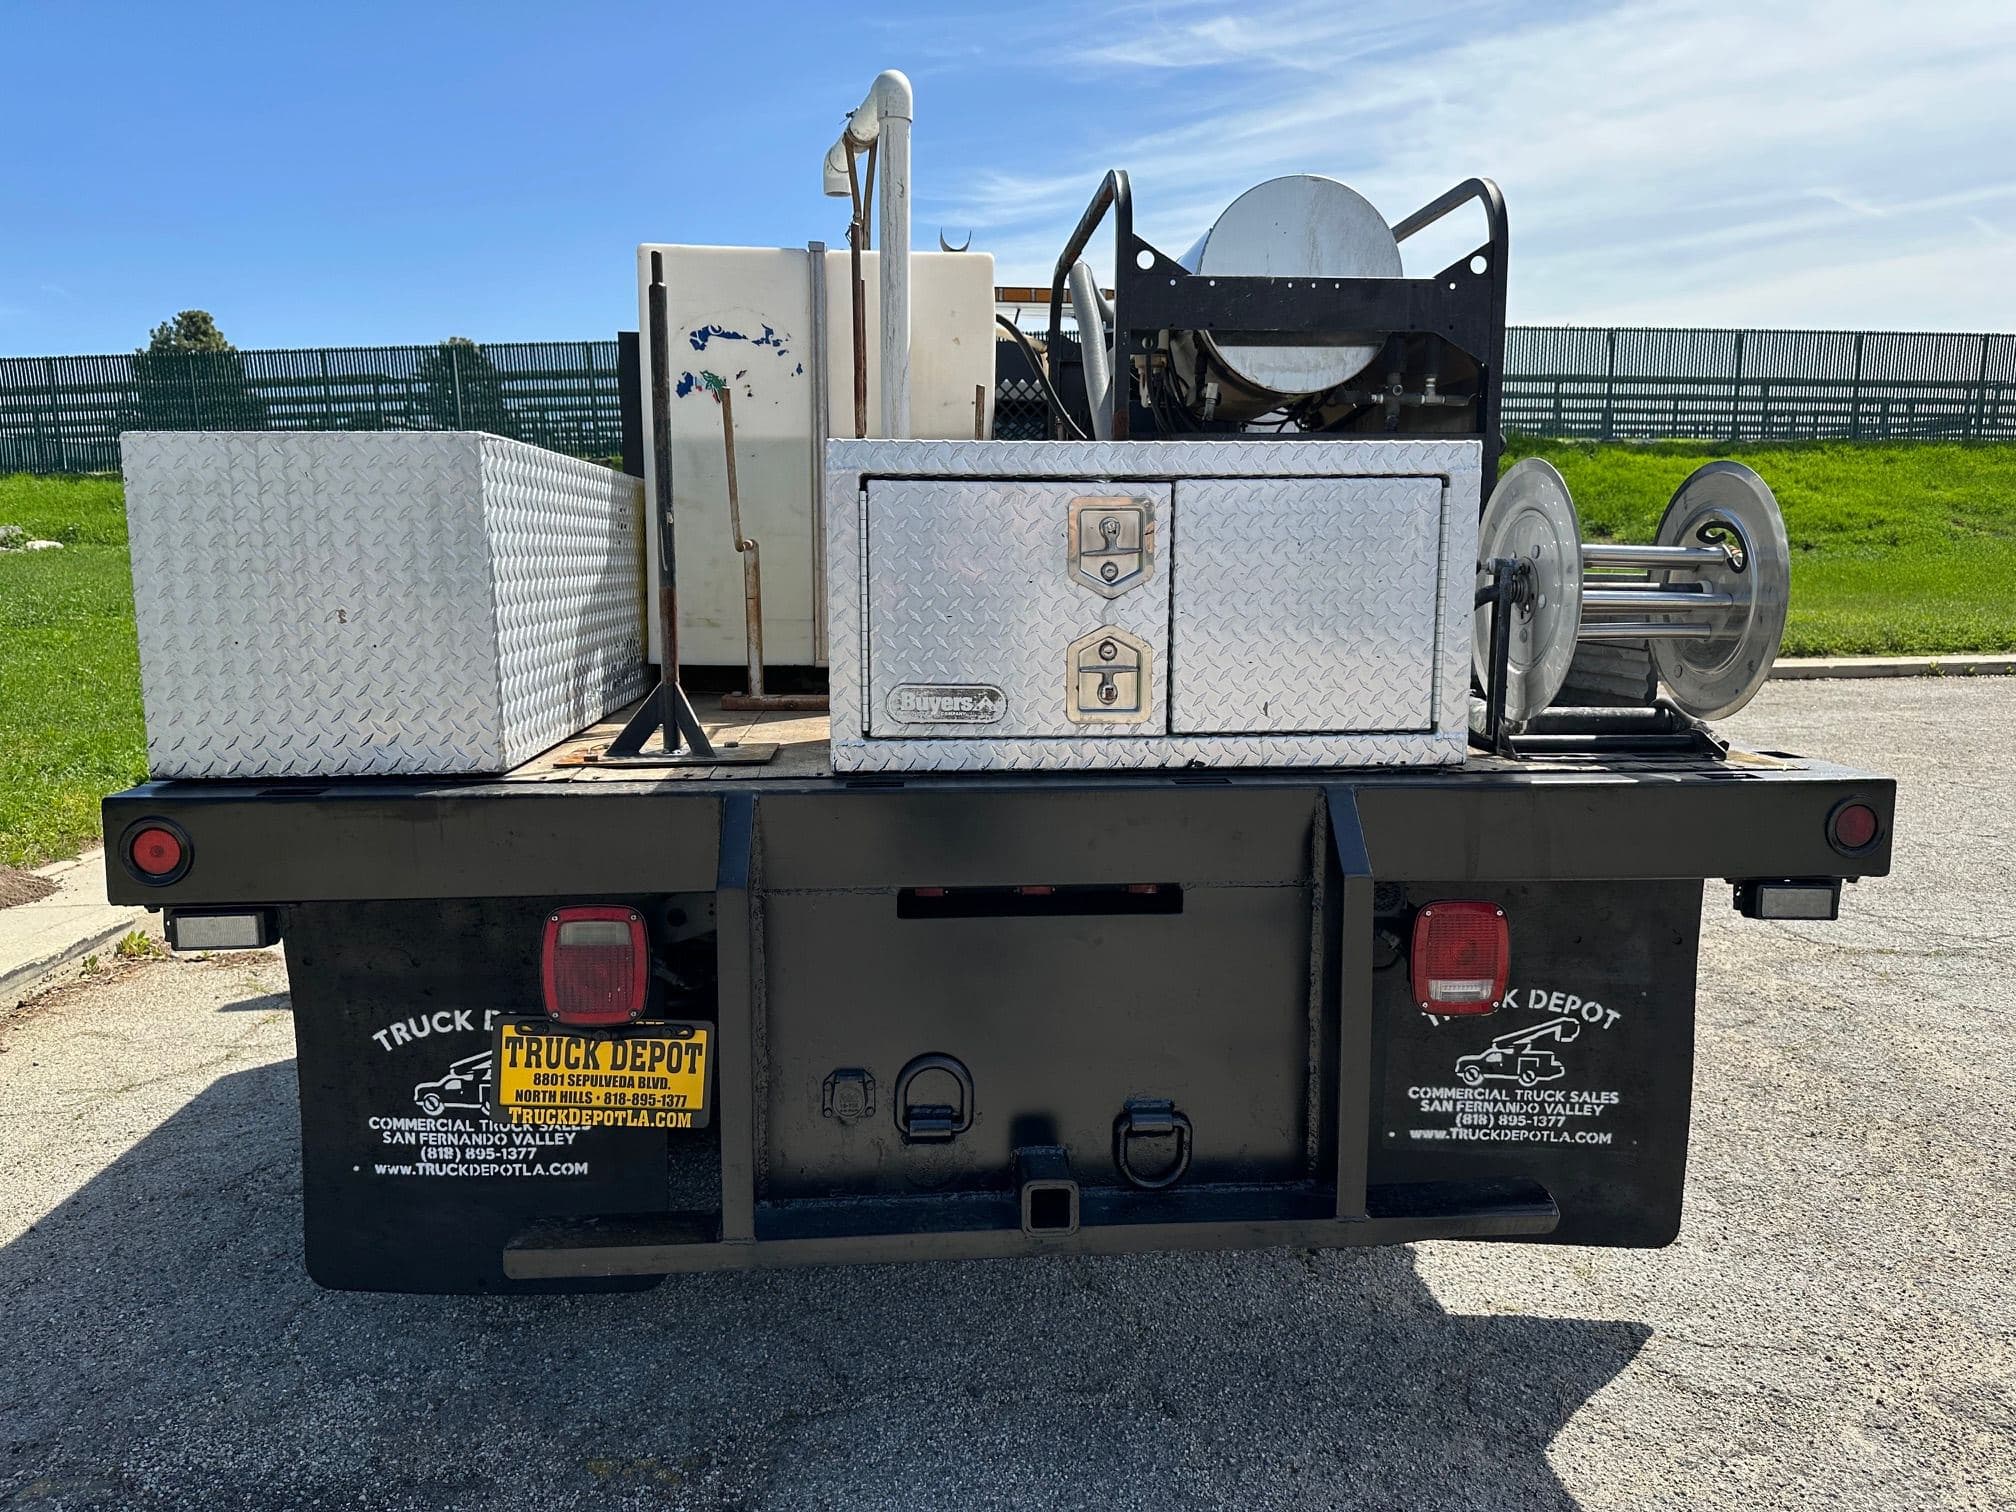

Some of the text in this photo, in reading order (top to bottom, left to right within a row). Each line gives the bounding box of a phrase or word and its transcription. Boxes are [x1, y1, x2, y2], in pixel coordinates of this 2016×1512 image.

[900, 691, 973, 715] Buyers
[1528, 990, 1622, 1031] DEPOT
[372, 1009, 474, 1051] TRUCK
[505, 1036, 703, 1075] TRUCK DEPOT
[533, 1073, 671, 1091] 8801 SEPULVEDA BLVD.
[515, 1089, 687, 1108] NORTH HILLS 818-895-1377
[1408, 1086, 1620, 1104] COMMERCIAL TRUCK SALES
[1420, 1099, 1605, 1117] SAN FERNANDO VALLEY
[368, 1116, 477, 1132] COMMERCIAL
[1455, 1113, 1567, 1128] (818) 895-1377
[382, 1131, 577, 1146] SAN FERNANDO VALLEY
[420, 1146, 538, 1162] (818) 895-1377
